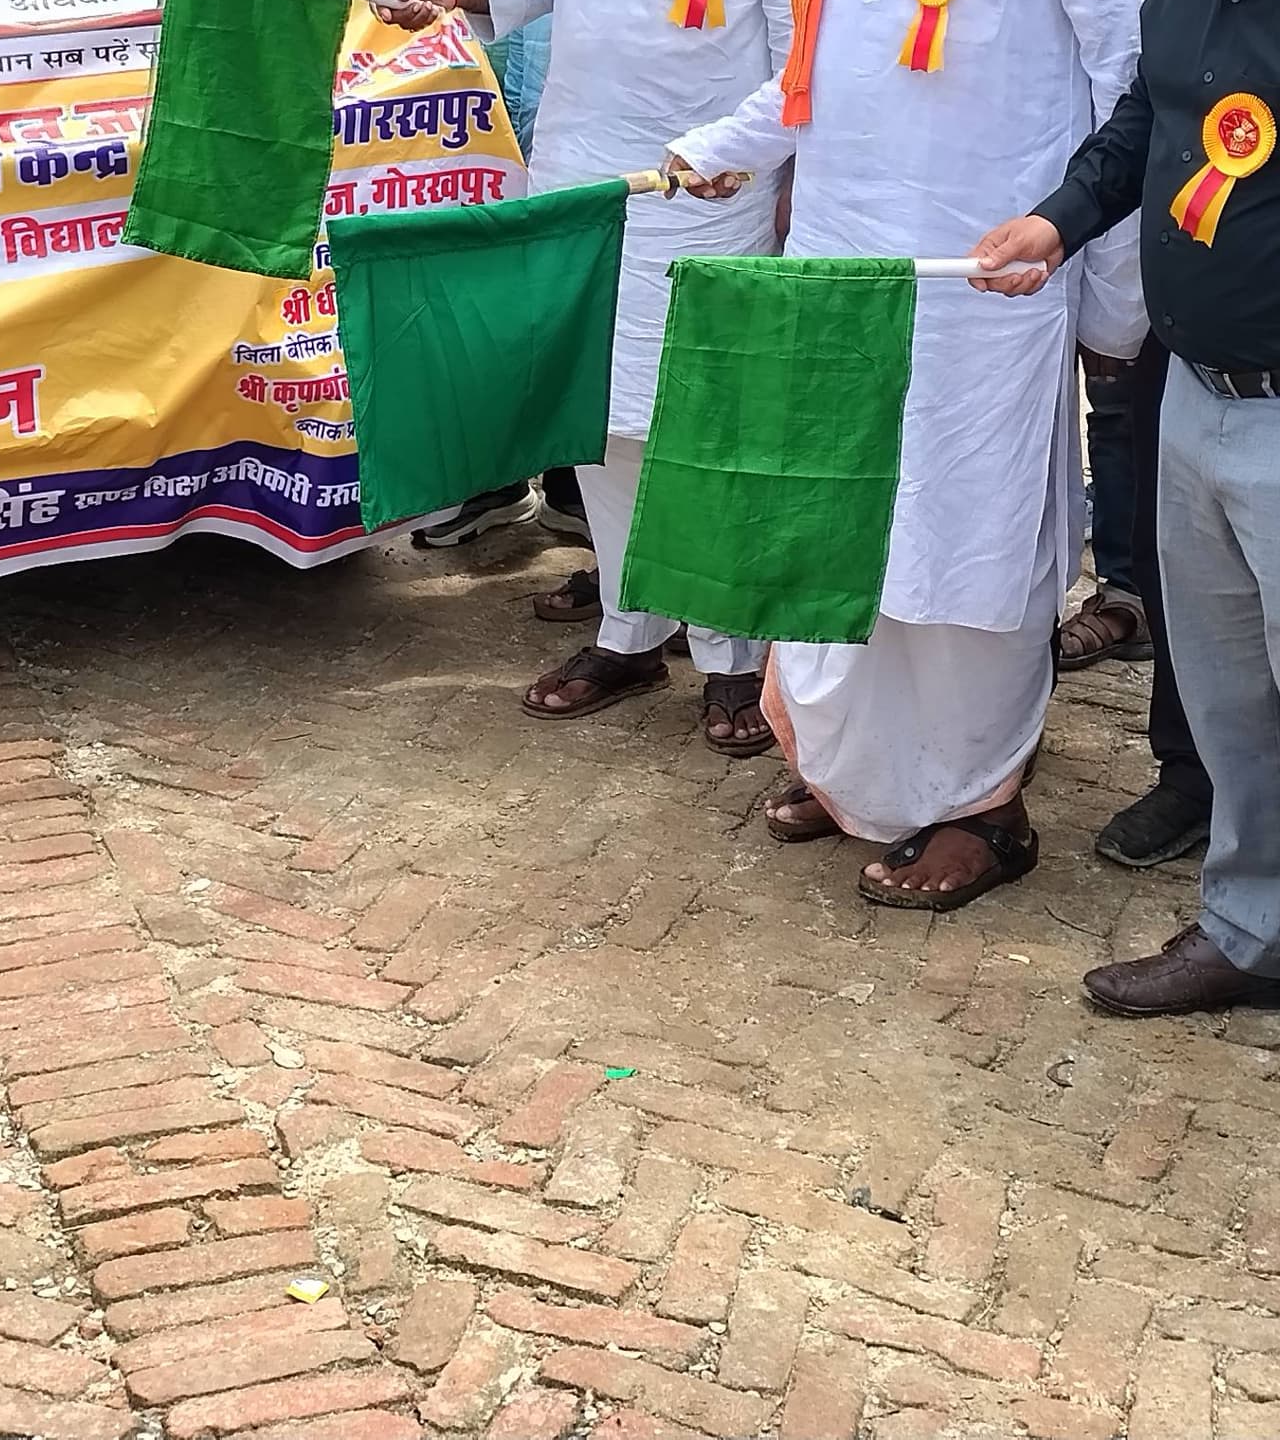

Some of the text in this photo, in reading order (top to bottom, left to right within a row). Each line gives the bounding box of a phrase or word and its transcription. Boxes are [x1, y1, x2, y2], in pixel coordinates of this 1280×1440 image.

[41, 45, 86, 67] सब
[93, 38, 132, 68] पढ़ें
[15, 138, 132, 187] केन्द्र
[332, 90, 498, 149] गोरखपुर
[0, 210, 131, 264] विद्याल
[372, 166, 508, 209] गोरखपुर
[283, 287, 312, 325] श्री
[235, 343, 282, 364] जिला
[286, 333, 333, 360] बेसिक
[238, 375, 269, 404] श्री
[296, 419, 344, 441] ब्लाक
[74, 484, 140, 510] खण्ड
[143, 471, 210, 499] शिक्षा
[211, 457, 313, 506] अधिकारी
